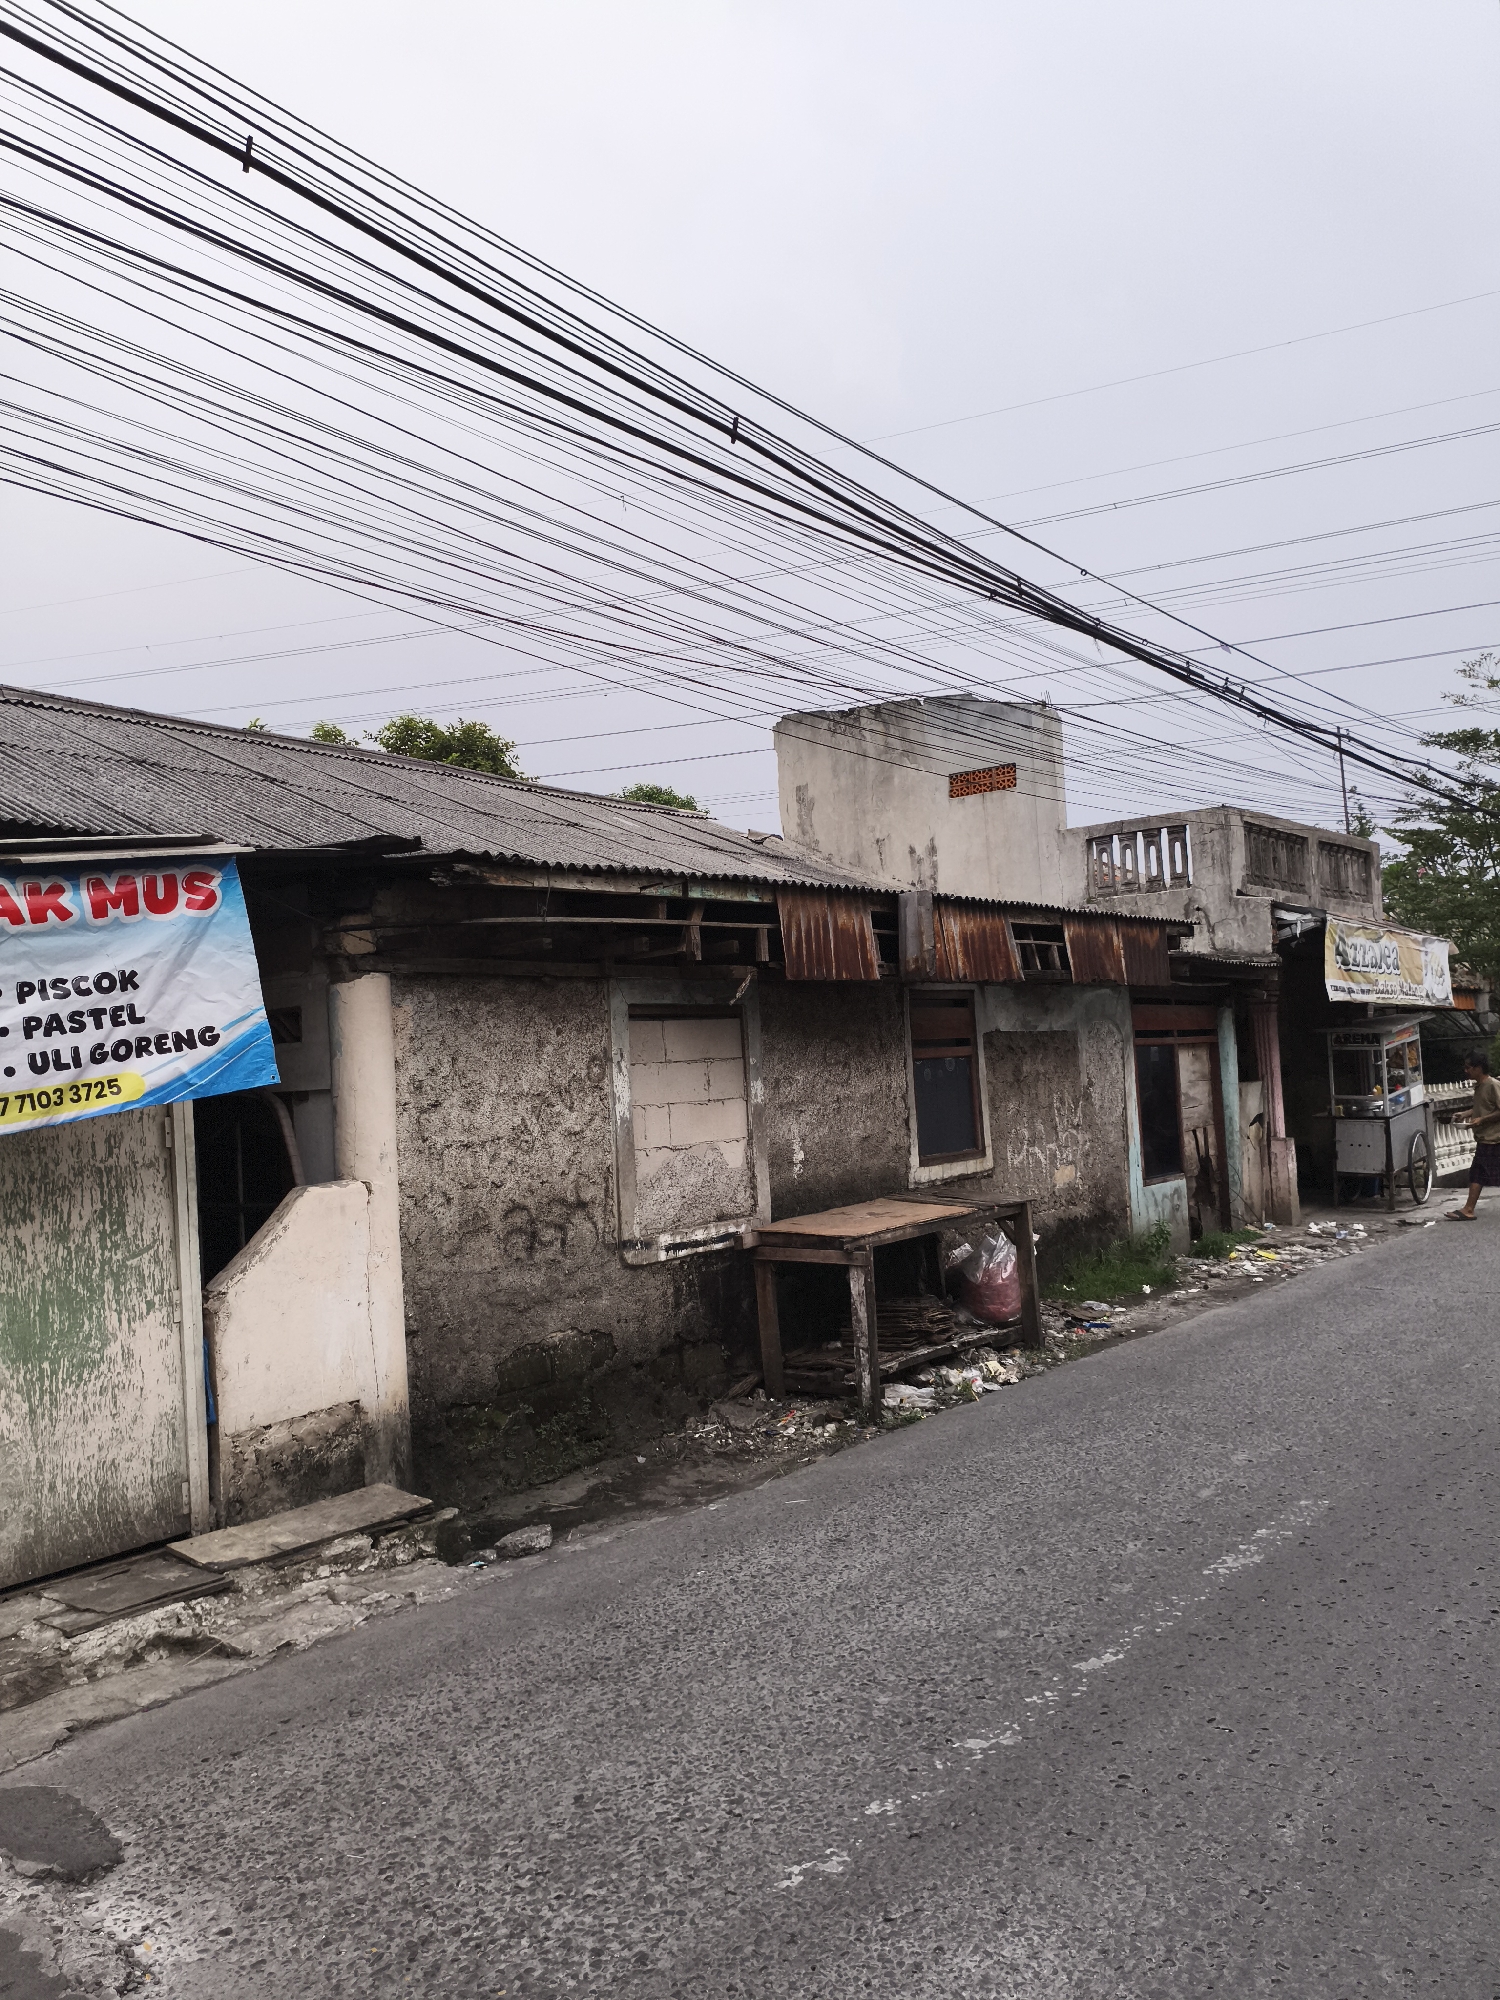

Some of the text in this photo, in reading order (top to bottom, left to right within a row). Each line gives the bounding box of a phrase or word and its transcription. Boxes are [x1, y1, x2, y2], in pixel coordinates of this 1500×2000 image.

[86, 871, 219, 920] MUS
[16, 969, 140, 1005] PISCOK
[22, 1003, 146, 1040] PASTEL
[27, 1025, 221, 1075] ULI GORENG
[14, 1087, 64, 1114] 7103
[68, 1077, 123, 1104] 3725
